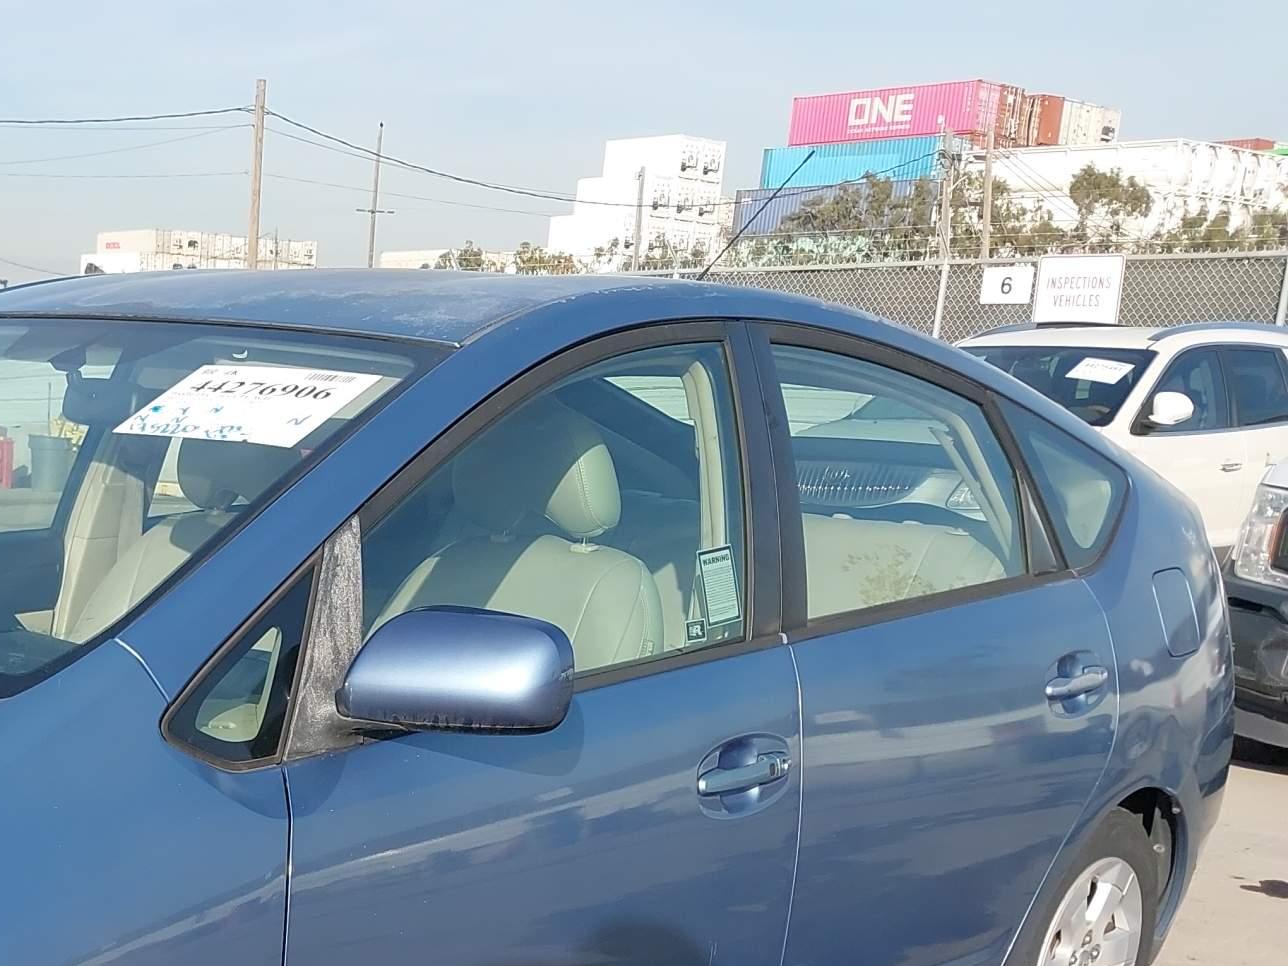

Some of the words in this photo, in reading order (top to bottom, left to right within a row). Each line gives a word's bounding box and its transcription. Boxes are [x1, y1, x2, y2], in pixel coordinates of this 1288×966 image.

[848, 94, 915, 126] ONE
[1000, 276, 1013, 295] 6
[1046, 276, 1111, 289] INSPECTIONS
[1053, 294, 1100, 307] VEHICLES
[190, 379, 337, 400] 44276906
[703, 554, 730, 566] WARNING
